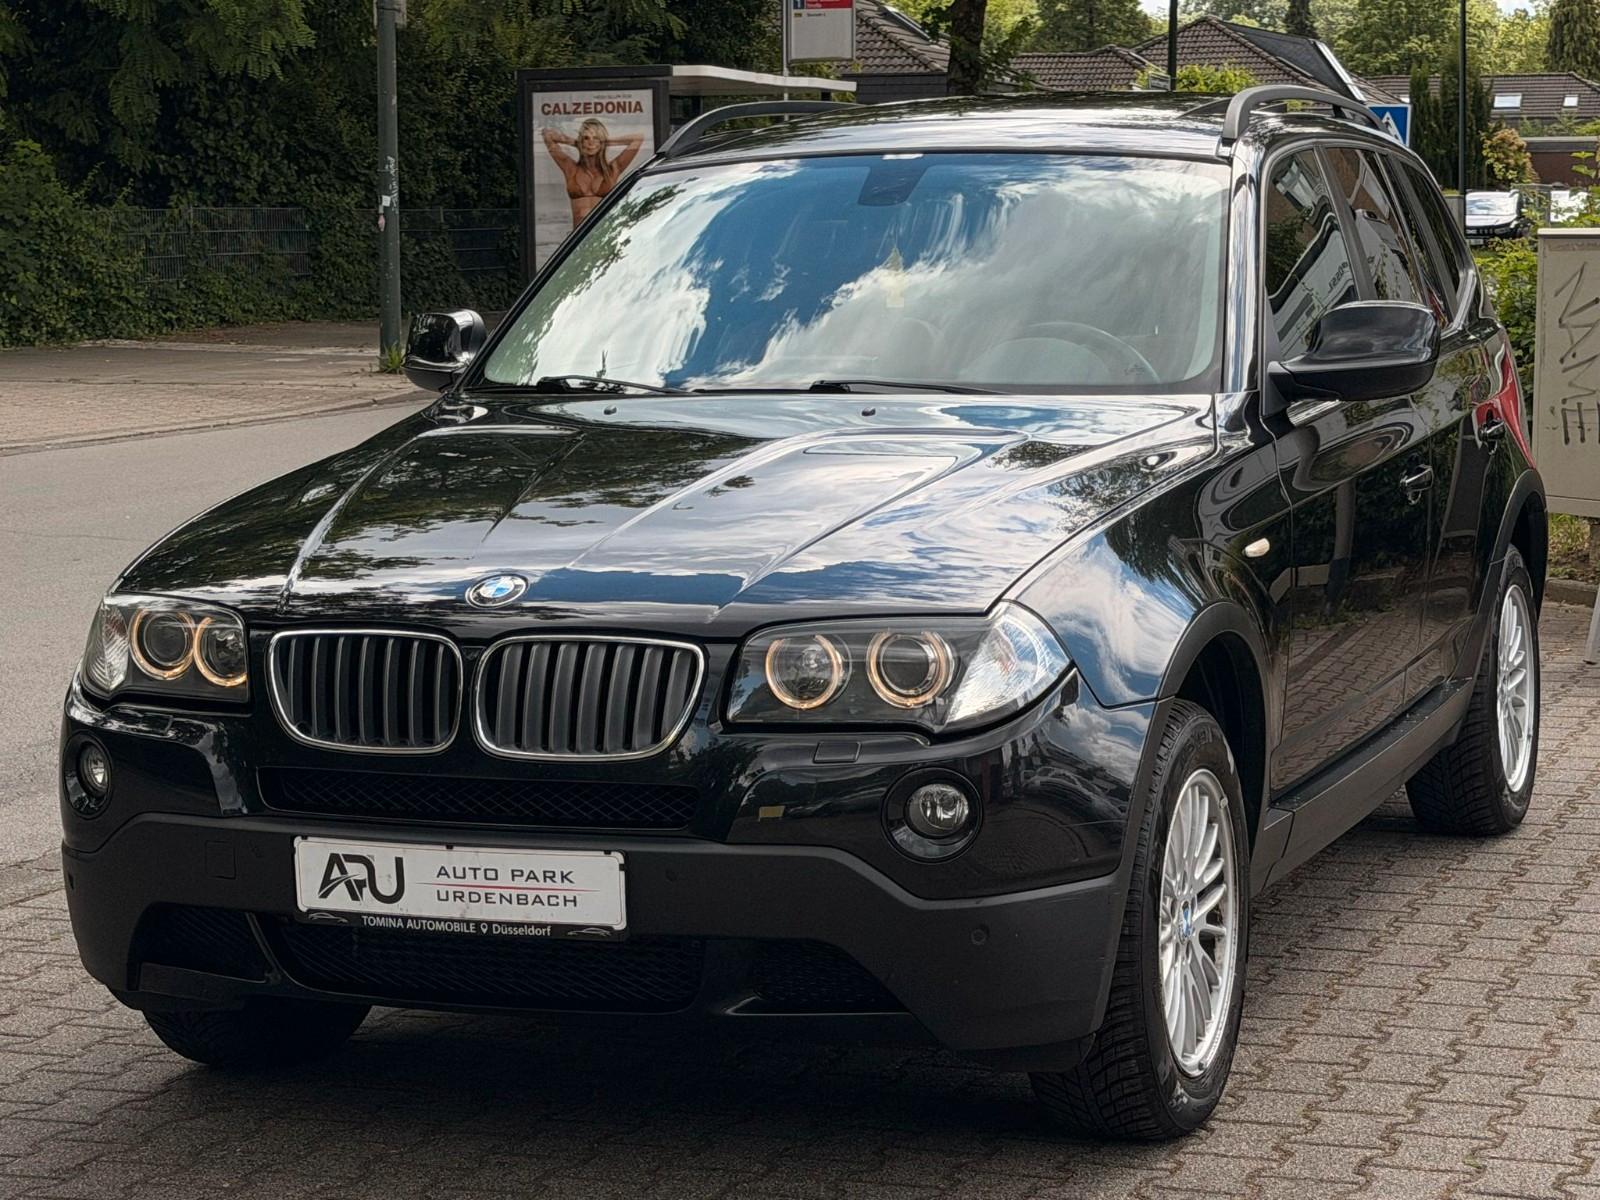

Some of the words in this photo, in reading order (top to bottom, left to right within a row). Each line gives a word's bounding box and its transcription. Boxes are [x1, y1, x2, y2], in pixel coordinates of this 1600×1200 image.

[541, 101, 644, 116] CALZEDONIA
[436, 865, 499, 881] AUTO
[511, 869, 575, 884] PARK
[436, 890, 578, 907] URDENBACH
[361, 915, 404, 929] TOMINA
[406, 918, 477, 934] AUTOMOBILE
[492, 923, 552, 937] Düsseldorf
